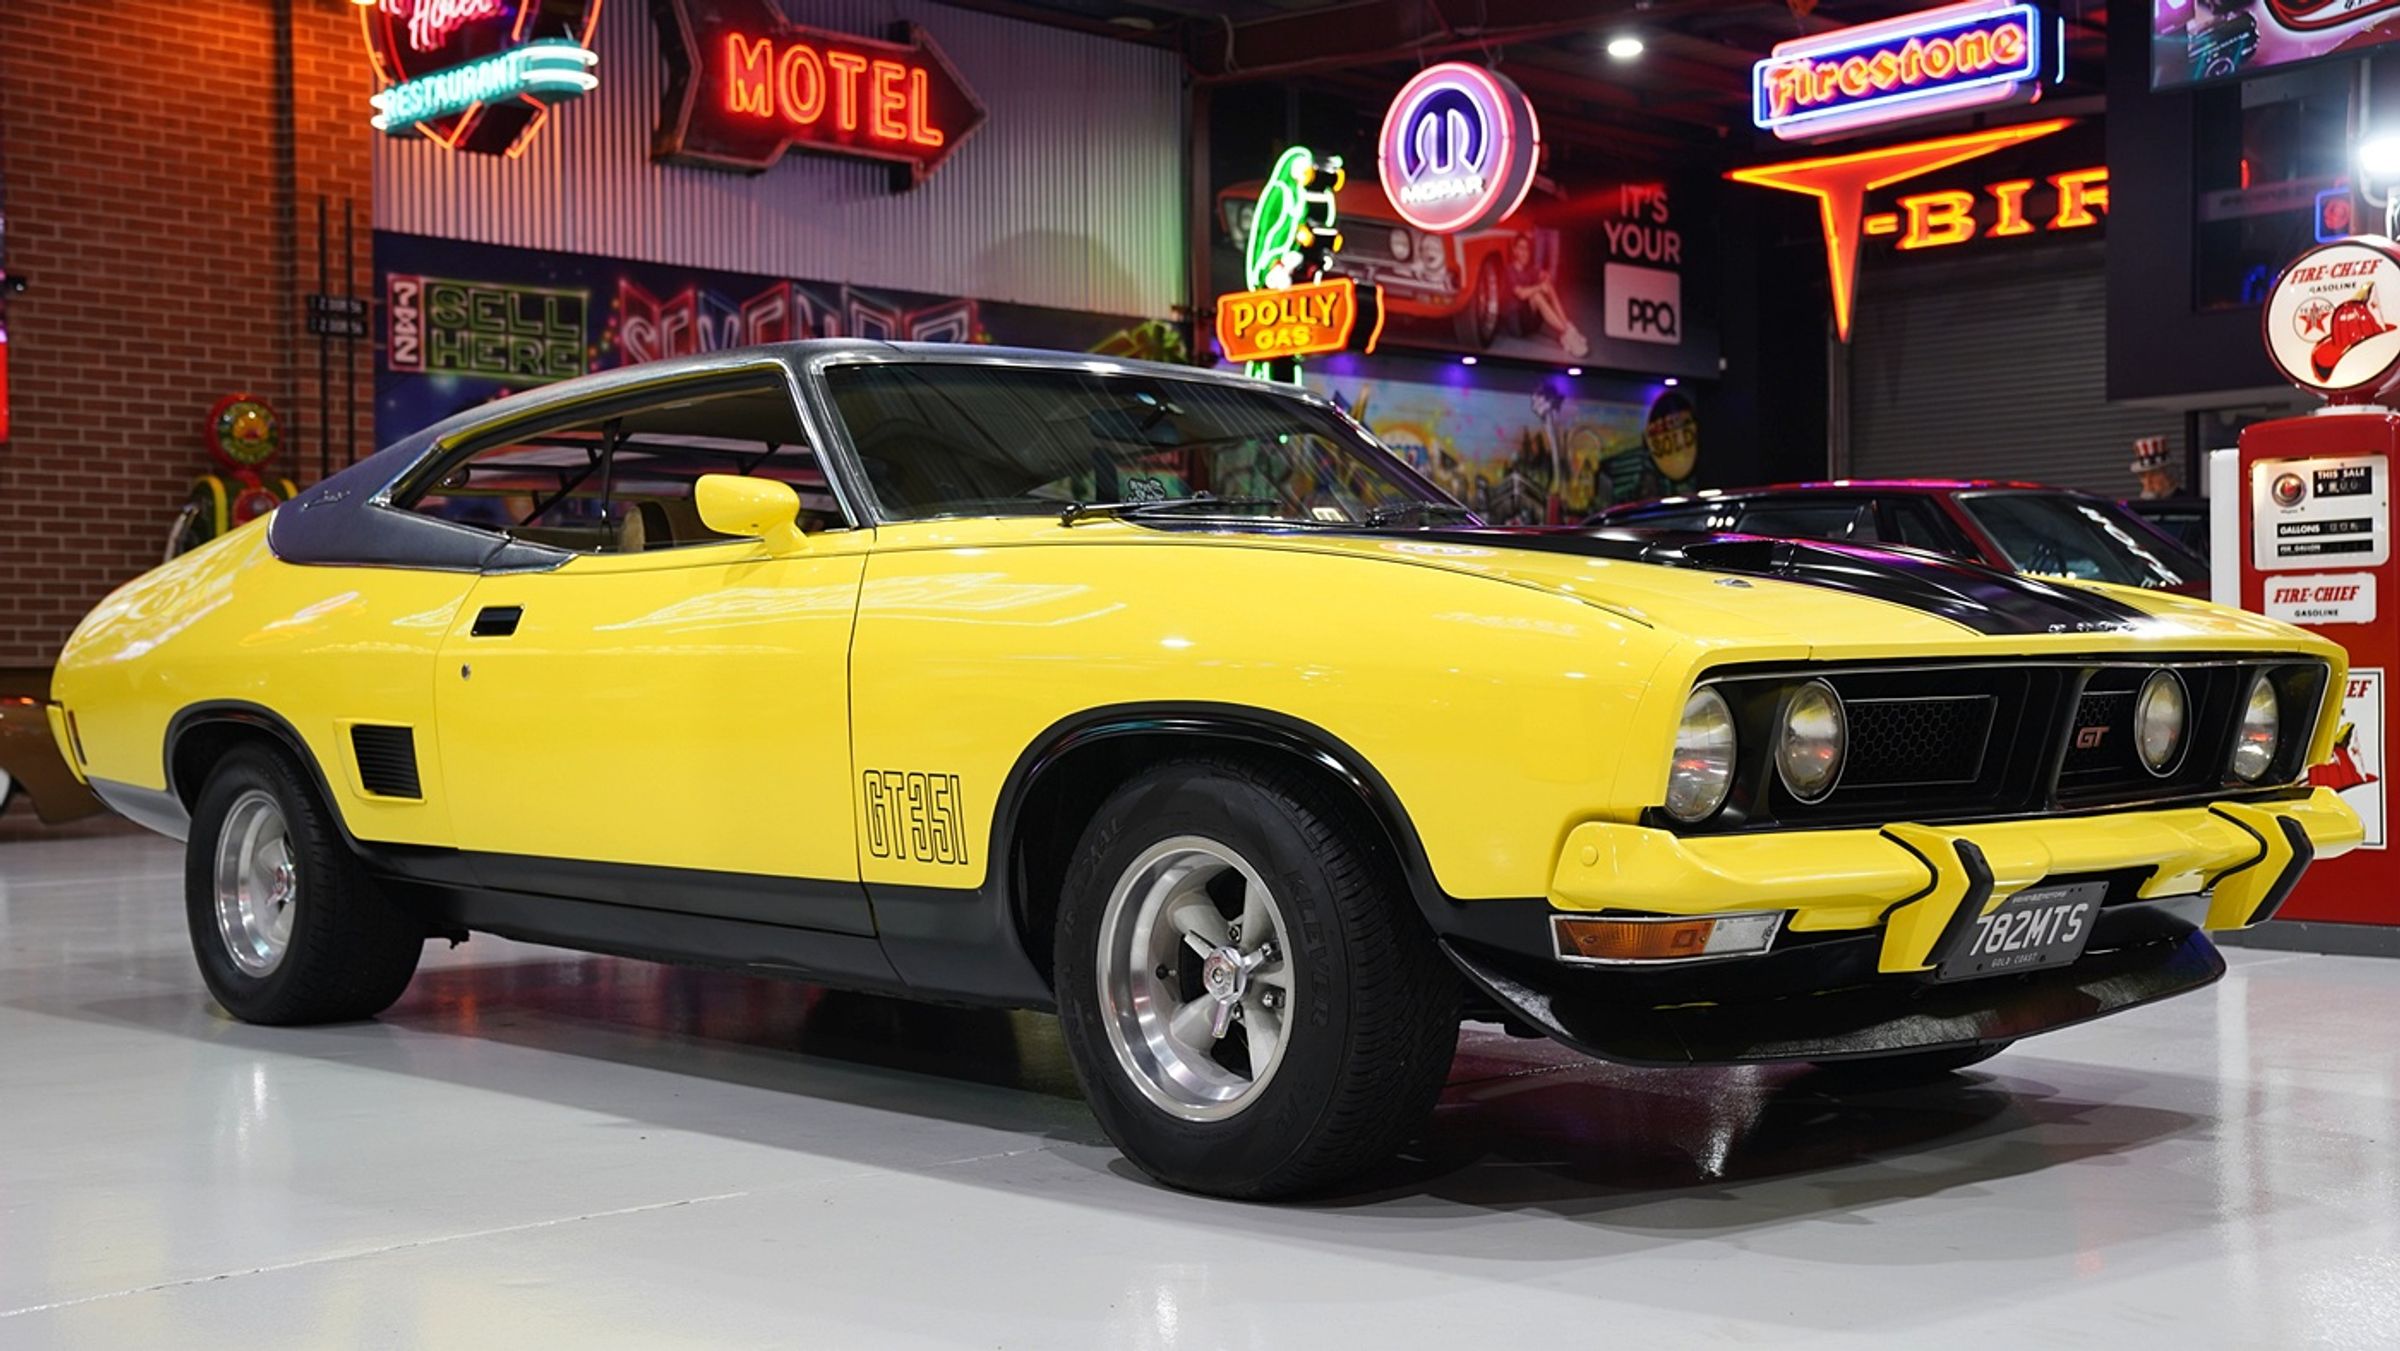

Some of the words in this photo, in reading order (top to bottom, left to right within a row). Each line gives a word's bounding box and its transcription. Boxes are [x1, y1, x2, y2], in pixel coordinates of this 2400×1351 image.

[384, 51, 523, 119] RESTAURANT
[727, 32, 944, 147] MOTEL
[1764, 22, 2026, 118] Firestone
[1400, 175, 1485, 204] MOPAR
[1620, 183, 1669, 224] IT'S
[1603, 219, 1681, 264] YOUR
[2290, 259, 2382, 286] FIRE-CHIEF
[2309, 281, 2357, 294] GASOLINE
[431, 285, 580, 339] SELL
[1231, 292, 1337, 337] POLLY
[1628, 297, 1677, 337] PPQ
[431, 329, 580, 378] HERE
[1255, 325, 1311, 350] GAS
[2317, 470, 2338, 480] THIS
[2343, 467, 2366, 478] SALE
[2280, 524, 2320, 535] GALLONS
[2273, 585, 2361, 604] FIRE-CHIEF
[2294, 608, 2339, 618] GASOLINE
[2076, 726, 2111, 749] GT
[1969, 903, 2089, 956] 782MTS
